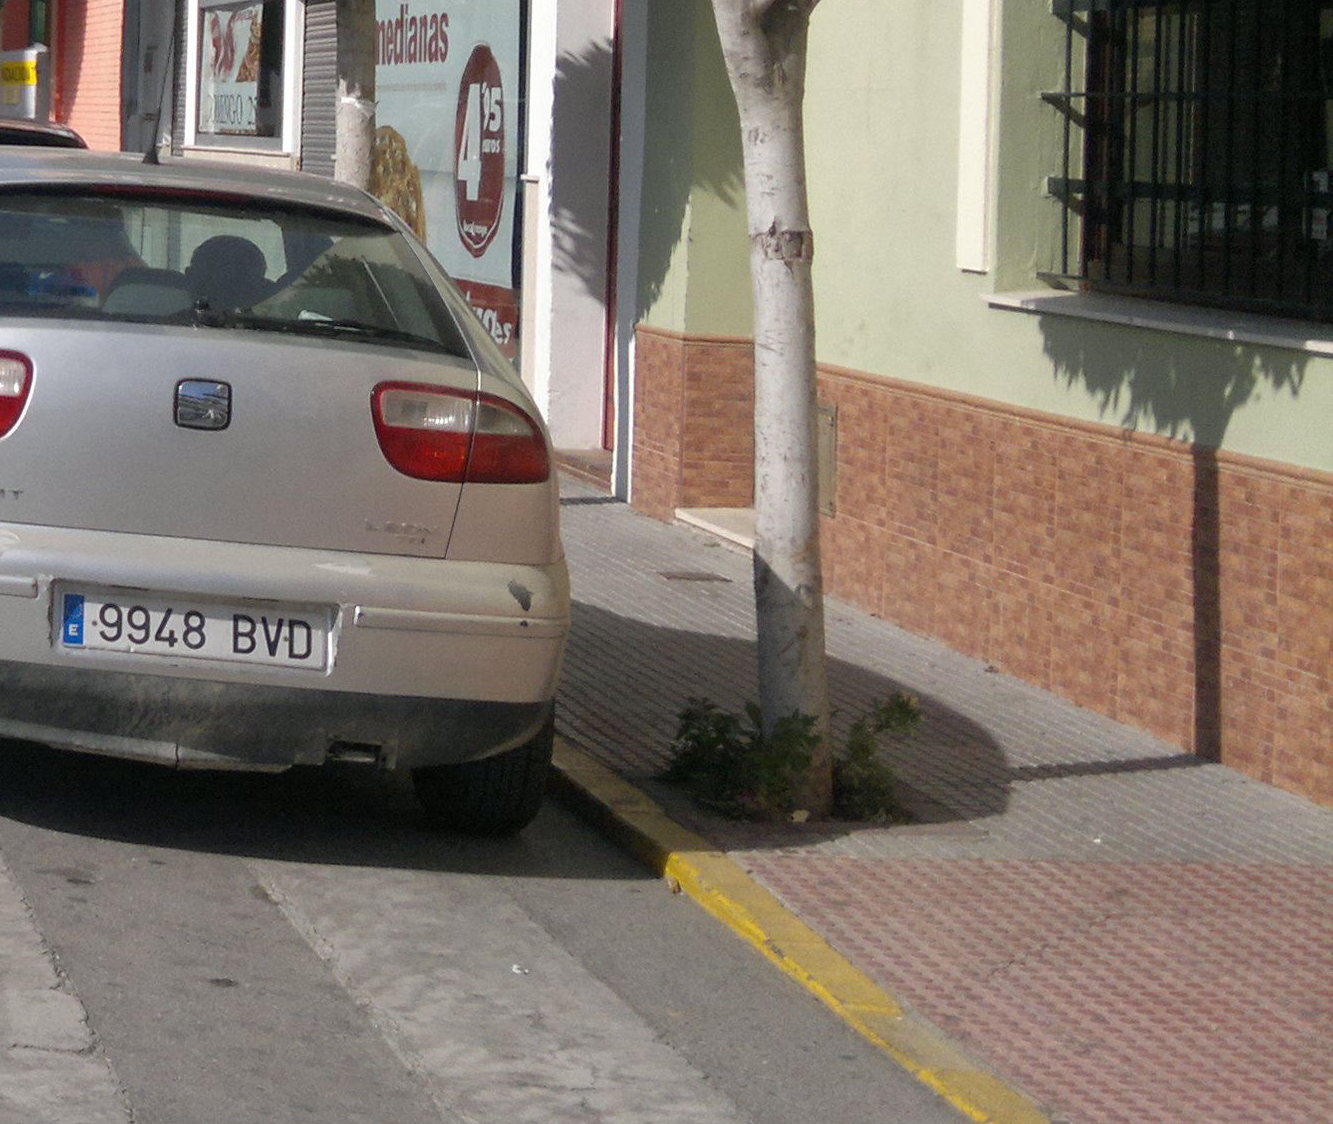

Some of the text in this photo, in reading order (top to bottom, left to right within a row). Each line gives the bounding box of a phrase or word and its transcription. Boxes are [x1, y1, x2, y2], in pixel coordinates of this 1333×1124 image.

[482, 138, 501, 154] euros
[67, 603, 313, 660] E 9948 BVD
